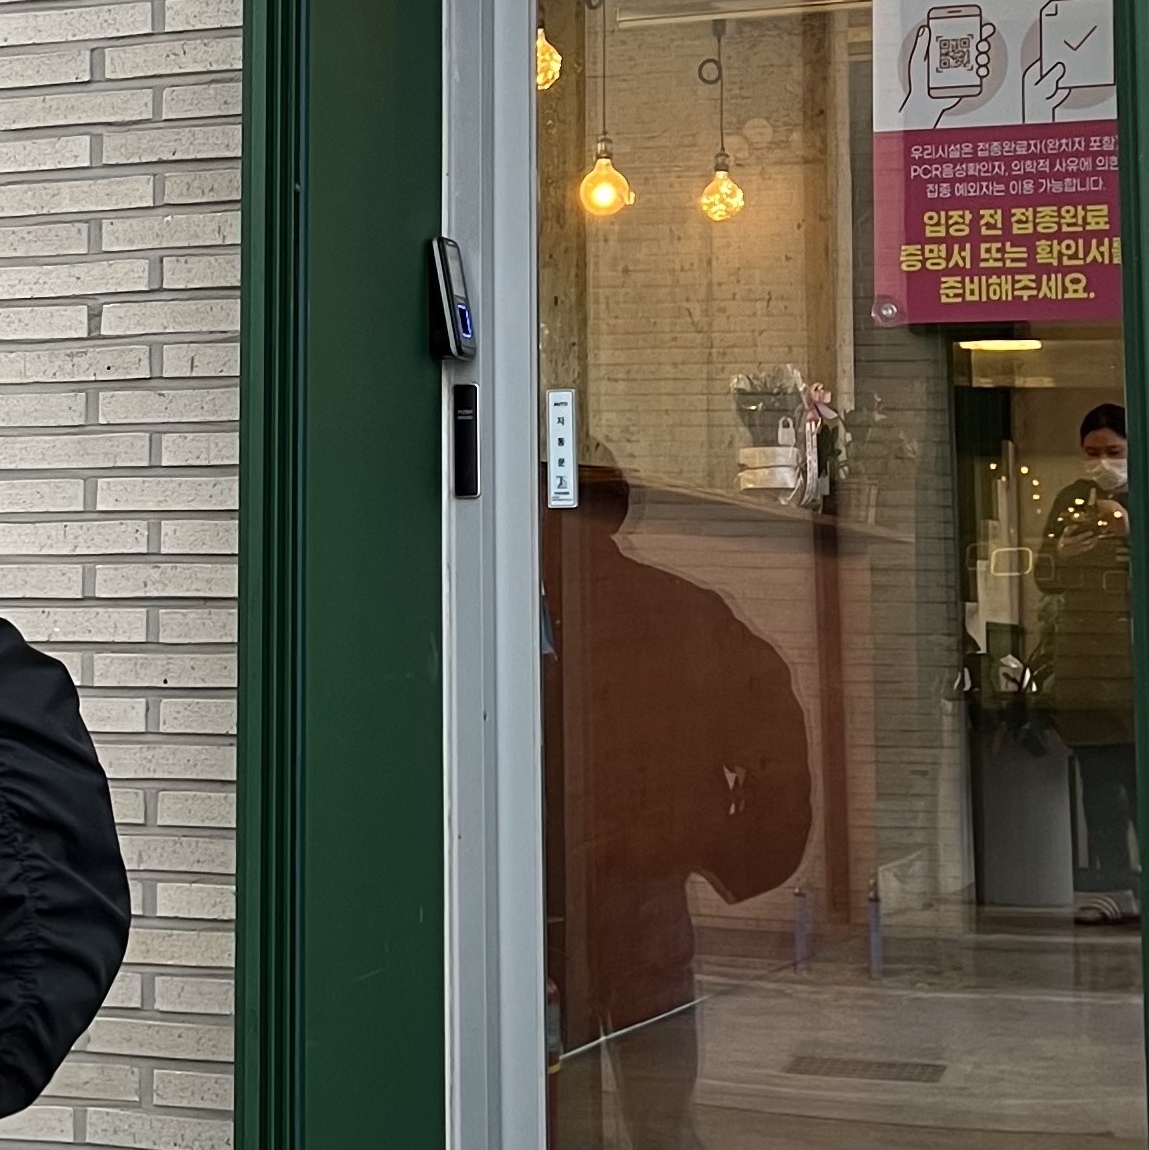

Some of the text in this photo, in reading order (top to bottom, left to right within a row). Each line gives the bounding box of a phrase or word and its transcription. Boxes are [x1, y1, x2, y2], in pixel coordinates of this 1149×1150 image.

[911, 142, 974, 160] 우리시설은
[1011, 158, 1050, 175] 의학적
[1053, 156, 1093, 173] 사유에
[926, 183, 951, 198] 접종
[954, 181, 1006, 197] 예외자는
[1009, 179, 1035, 195] 이용
[923, 204, 1110, 238] 입장 전 접종완료
[900, 243, 971, 272] 증명서
[979, 241, 1028, 268] 또는
[939, 272, 1096, 304] 준비해주세요.
